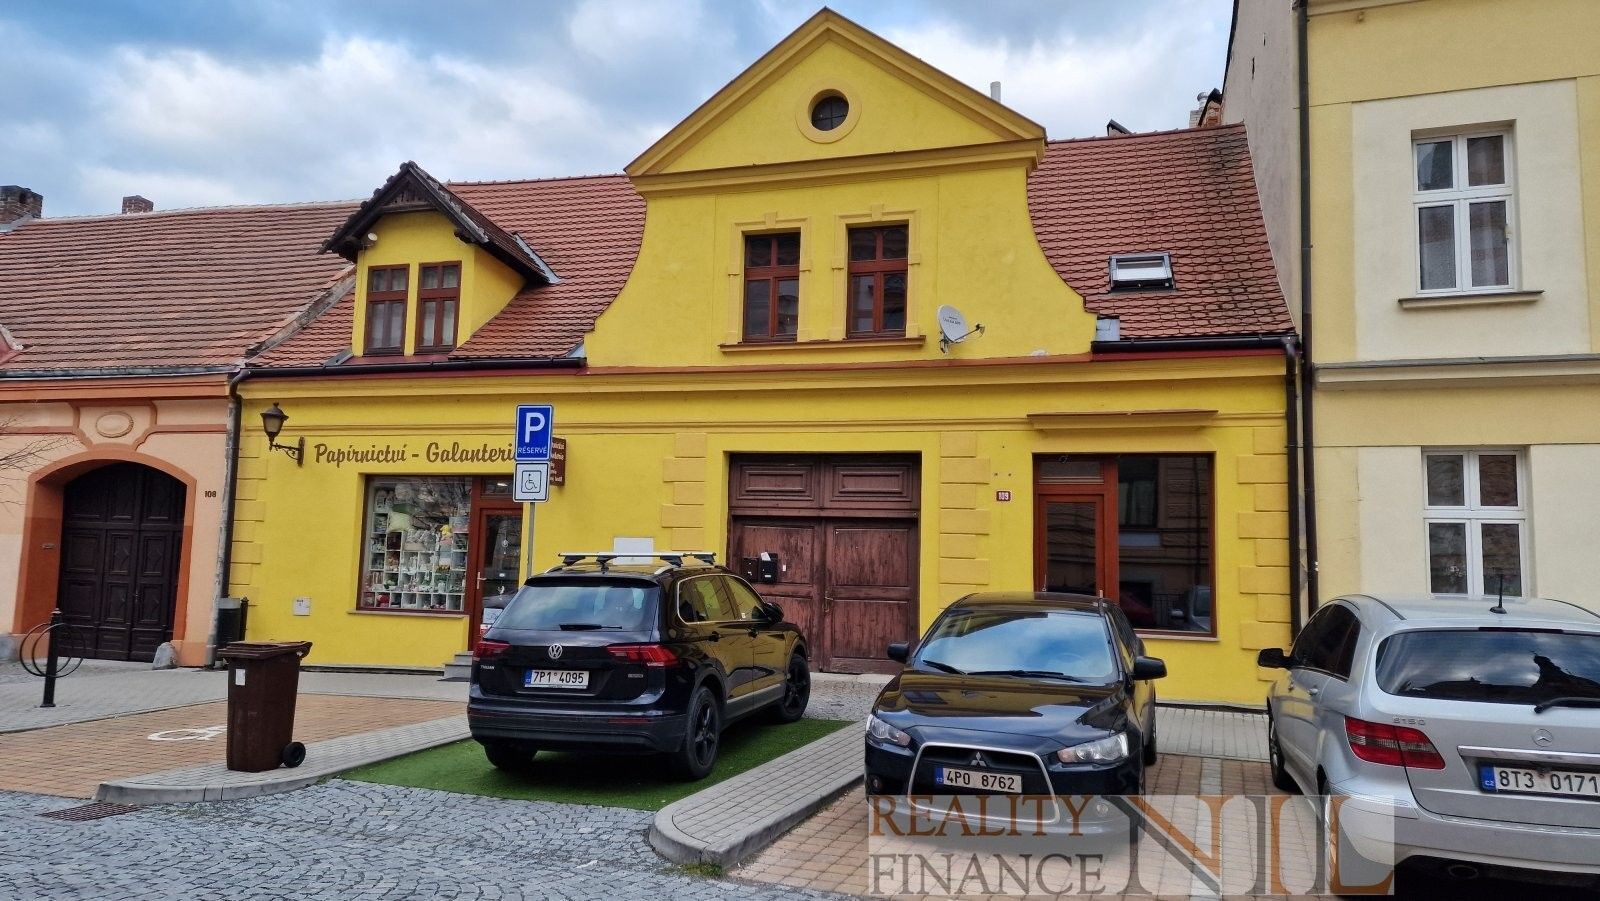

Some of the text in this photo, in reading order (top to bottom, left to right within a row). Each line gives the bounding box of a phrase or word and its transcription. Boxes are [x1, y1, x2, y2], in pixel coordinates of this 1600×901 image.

[524, 412, 546, 443] P
[313, 443, 408, 468] Papírnictví
[426, 442, 516, 463] Galanteri
[517, 446, 547, 454] RÉSERVÉ
[533, 671, 585, 684] 7P1 4095
[946, 770, 1015, 790] 4P0 8762
[1499, 770, 1599, 794] 8T3 0171
